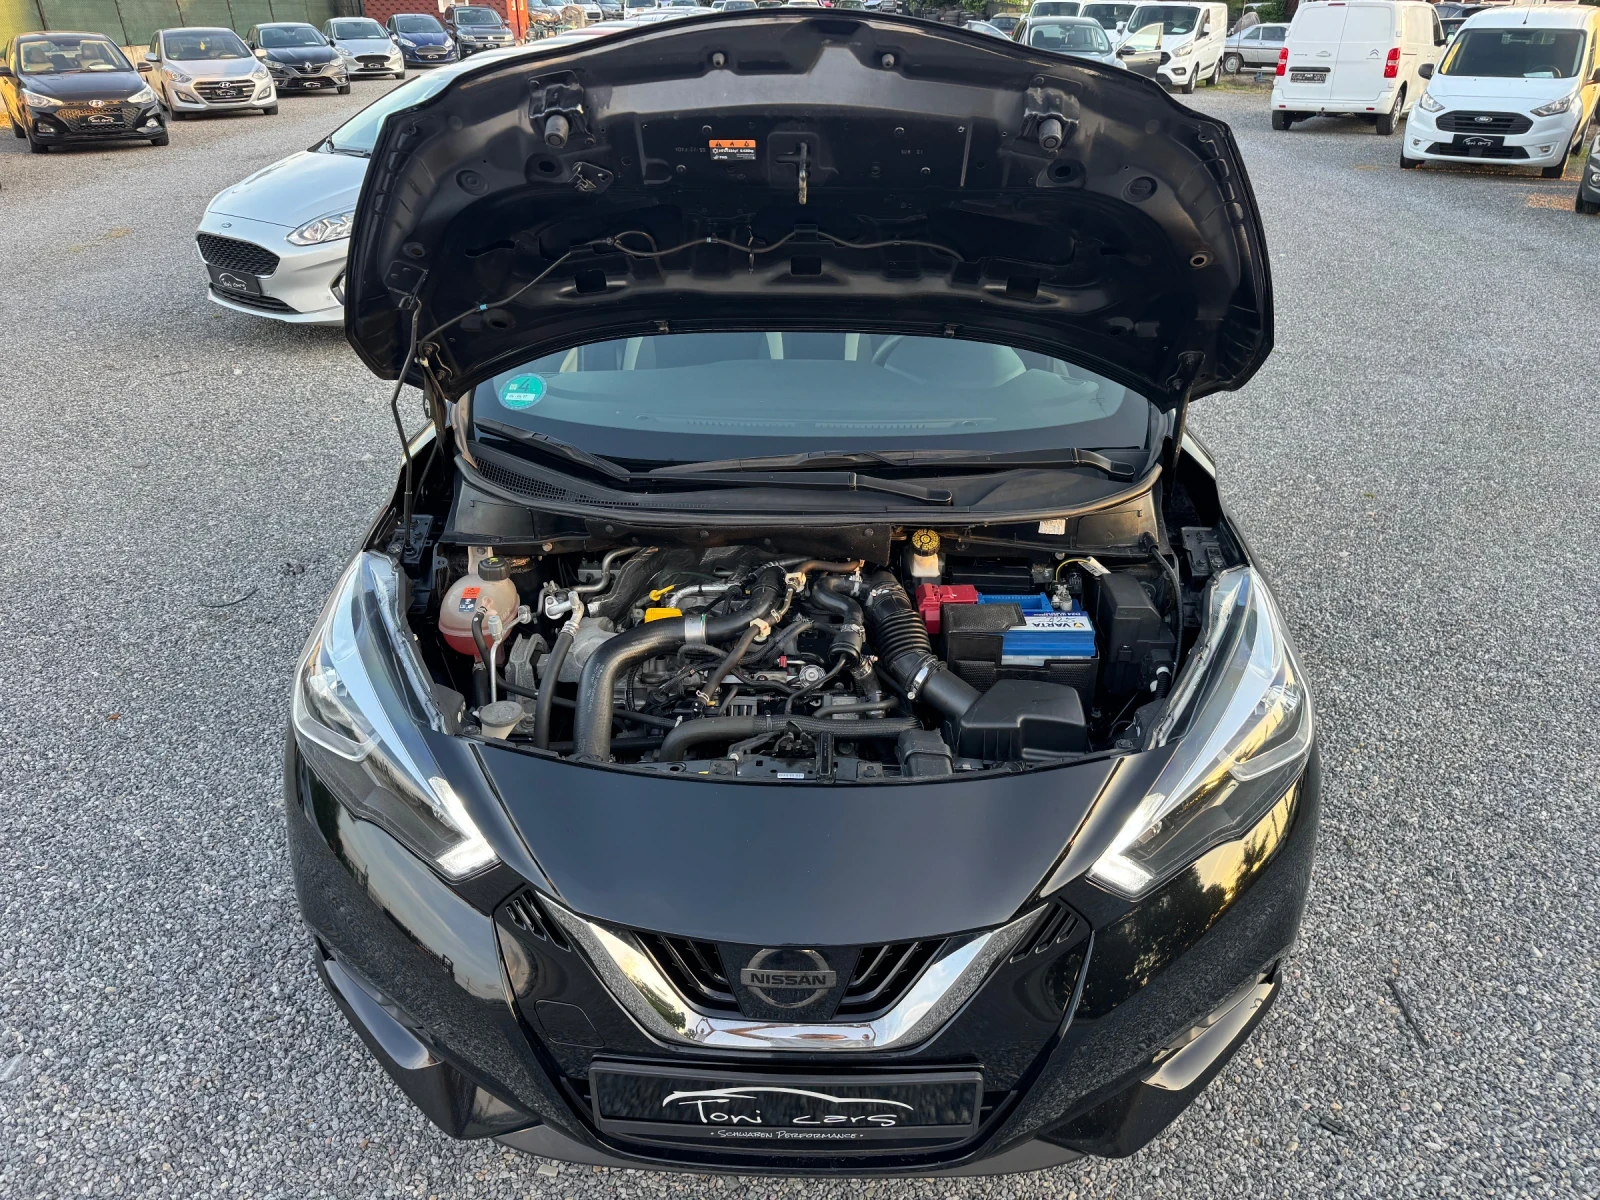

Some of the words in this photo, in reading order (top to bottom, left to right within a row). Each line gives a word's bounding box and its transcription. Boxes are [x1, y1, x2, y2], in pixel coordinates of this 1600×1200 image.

[517, 378, 530, 391] 4
[750, 972, 826, 986] NISSAN
[679, 1099, 762, 1124] Toni
[792, 1114, 898, 1127] cars
